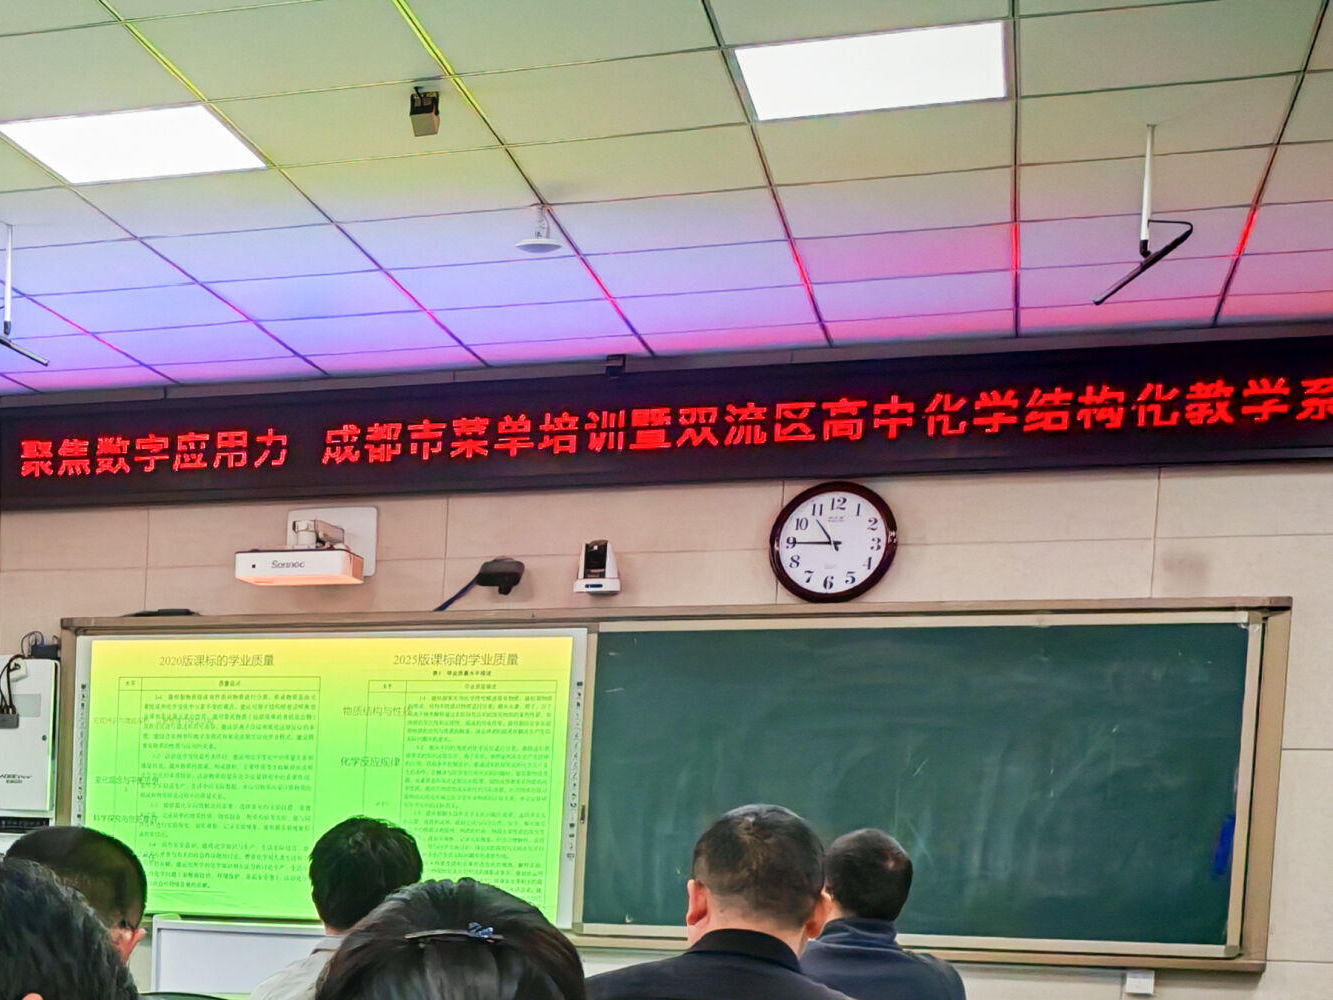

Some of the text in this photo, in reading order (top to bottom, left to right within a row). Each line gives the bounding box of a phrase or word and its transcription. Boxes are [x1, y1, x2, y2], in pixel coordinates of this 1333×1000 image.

[21, 428, 287, 477] 聚焦数字应用力
[811, 503, 823, 516] 11
[830, 497, 847, 511] 12
[856, 503, 861, 516] 1
[795, 517, 809, 531] 10
[867, 517, 878, 531] 2
[785, 536, 797, 549] 9
[870, 537, 881, 551] 3
[789, 555, 800, 568] 8
[862, 556, 872, 570] 4
[804, 570, 814, 583] 7
[823, 576, 834, 590] 6
[844, 571, 856, 584] 5
[158, 653, 275, 668] 2020版课标的学业质量
[393, 652, 520, 667] 2025版课标的学业质量
